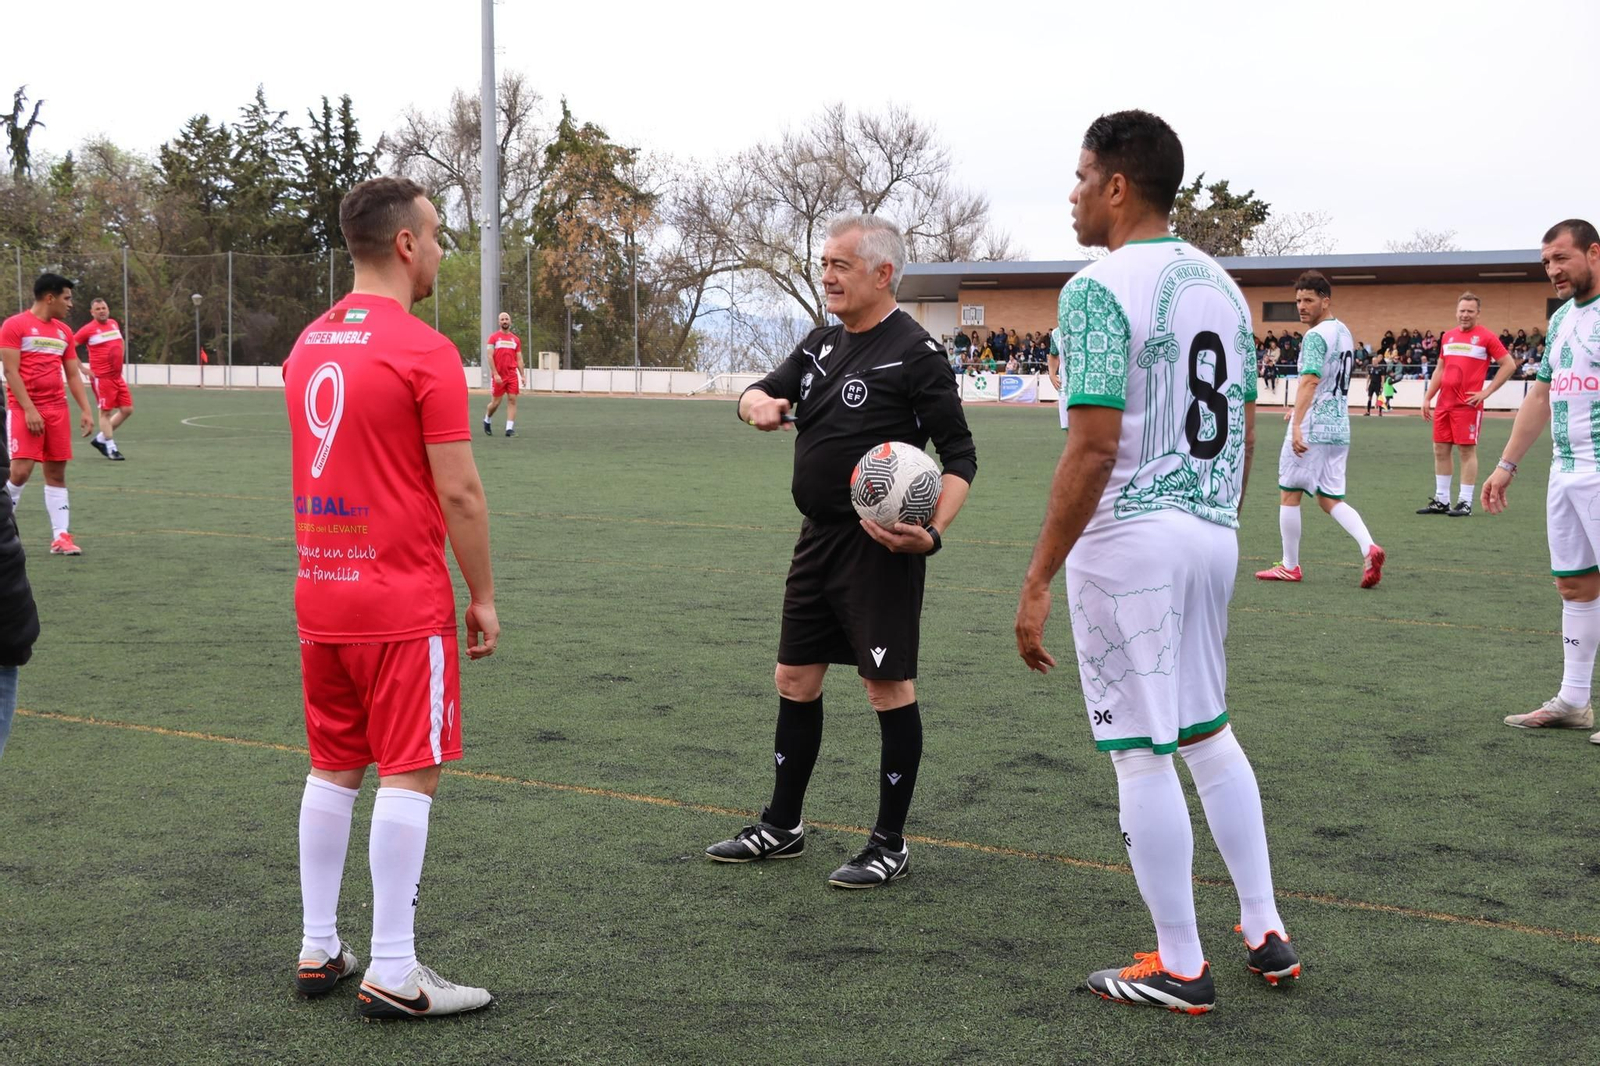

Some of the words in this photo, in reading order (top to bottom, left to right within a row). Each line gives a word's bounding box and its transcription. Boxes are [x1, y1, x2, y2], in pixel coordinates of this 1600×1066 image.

[1156, 276, 1177, 332] DOMINATOR
[1174, 266, 1211, 281] HERCULES
[304, 331, 371, 344] HIPERMUEBLE
[1333, 350, 1353, 396] 10
[1550, 372, 1599, 396] alpha
[1185, 331, 1229, 460] 8
[304, 361, 345, 479] 9
[328, 524, 369, 535] LEVANTE
[323, 547, 344, 559] un
[347, 544, 377, 560] club
[312, 564, 360, 585] familia
